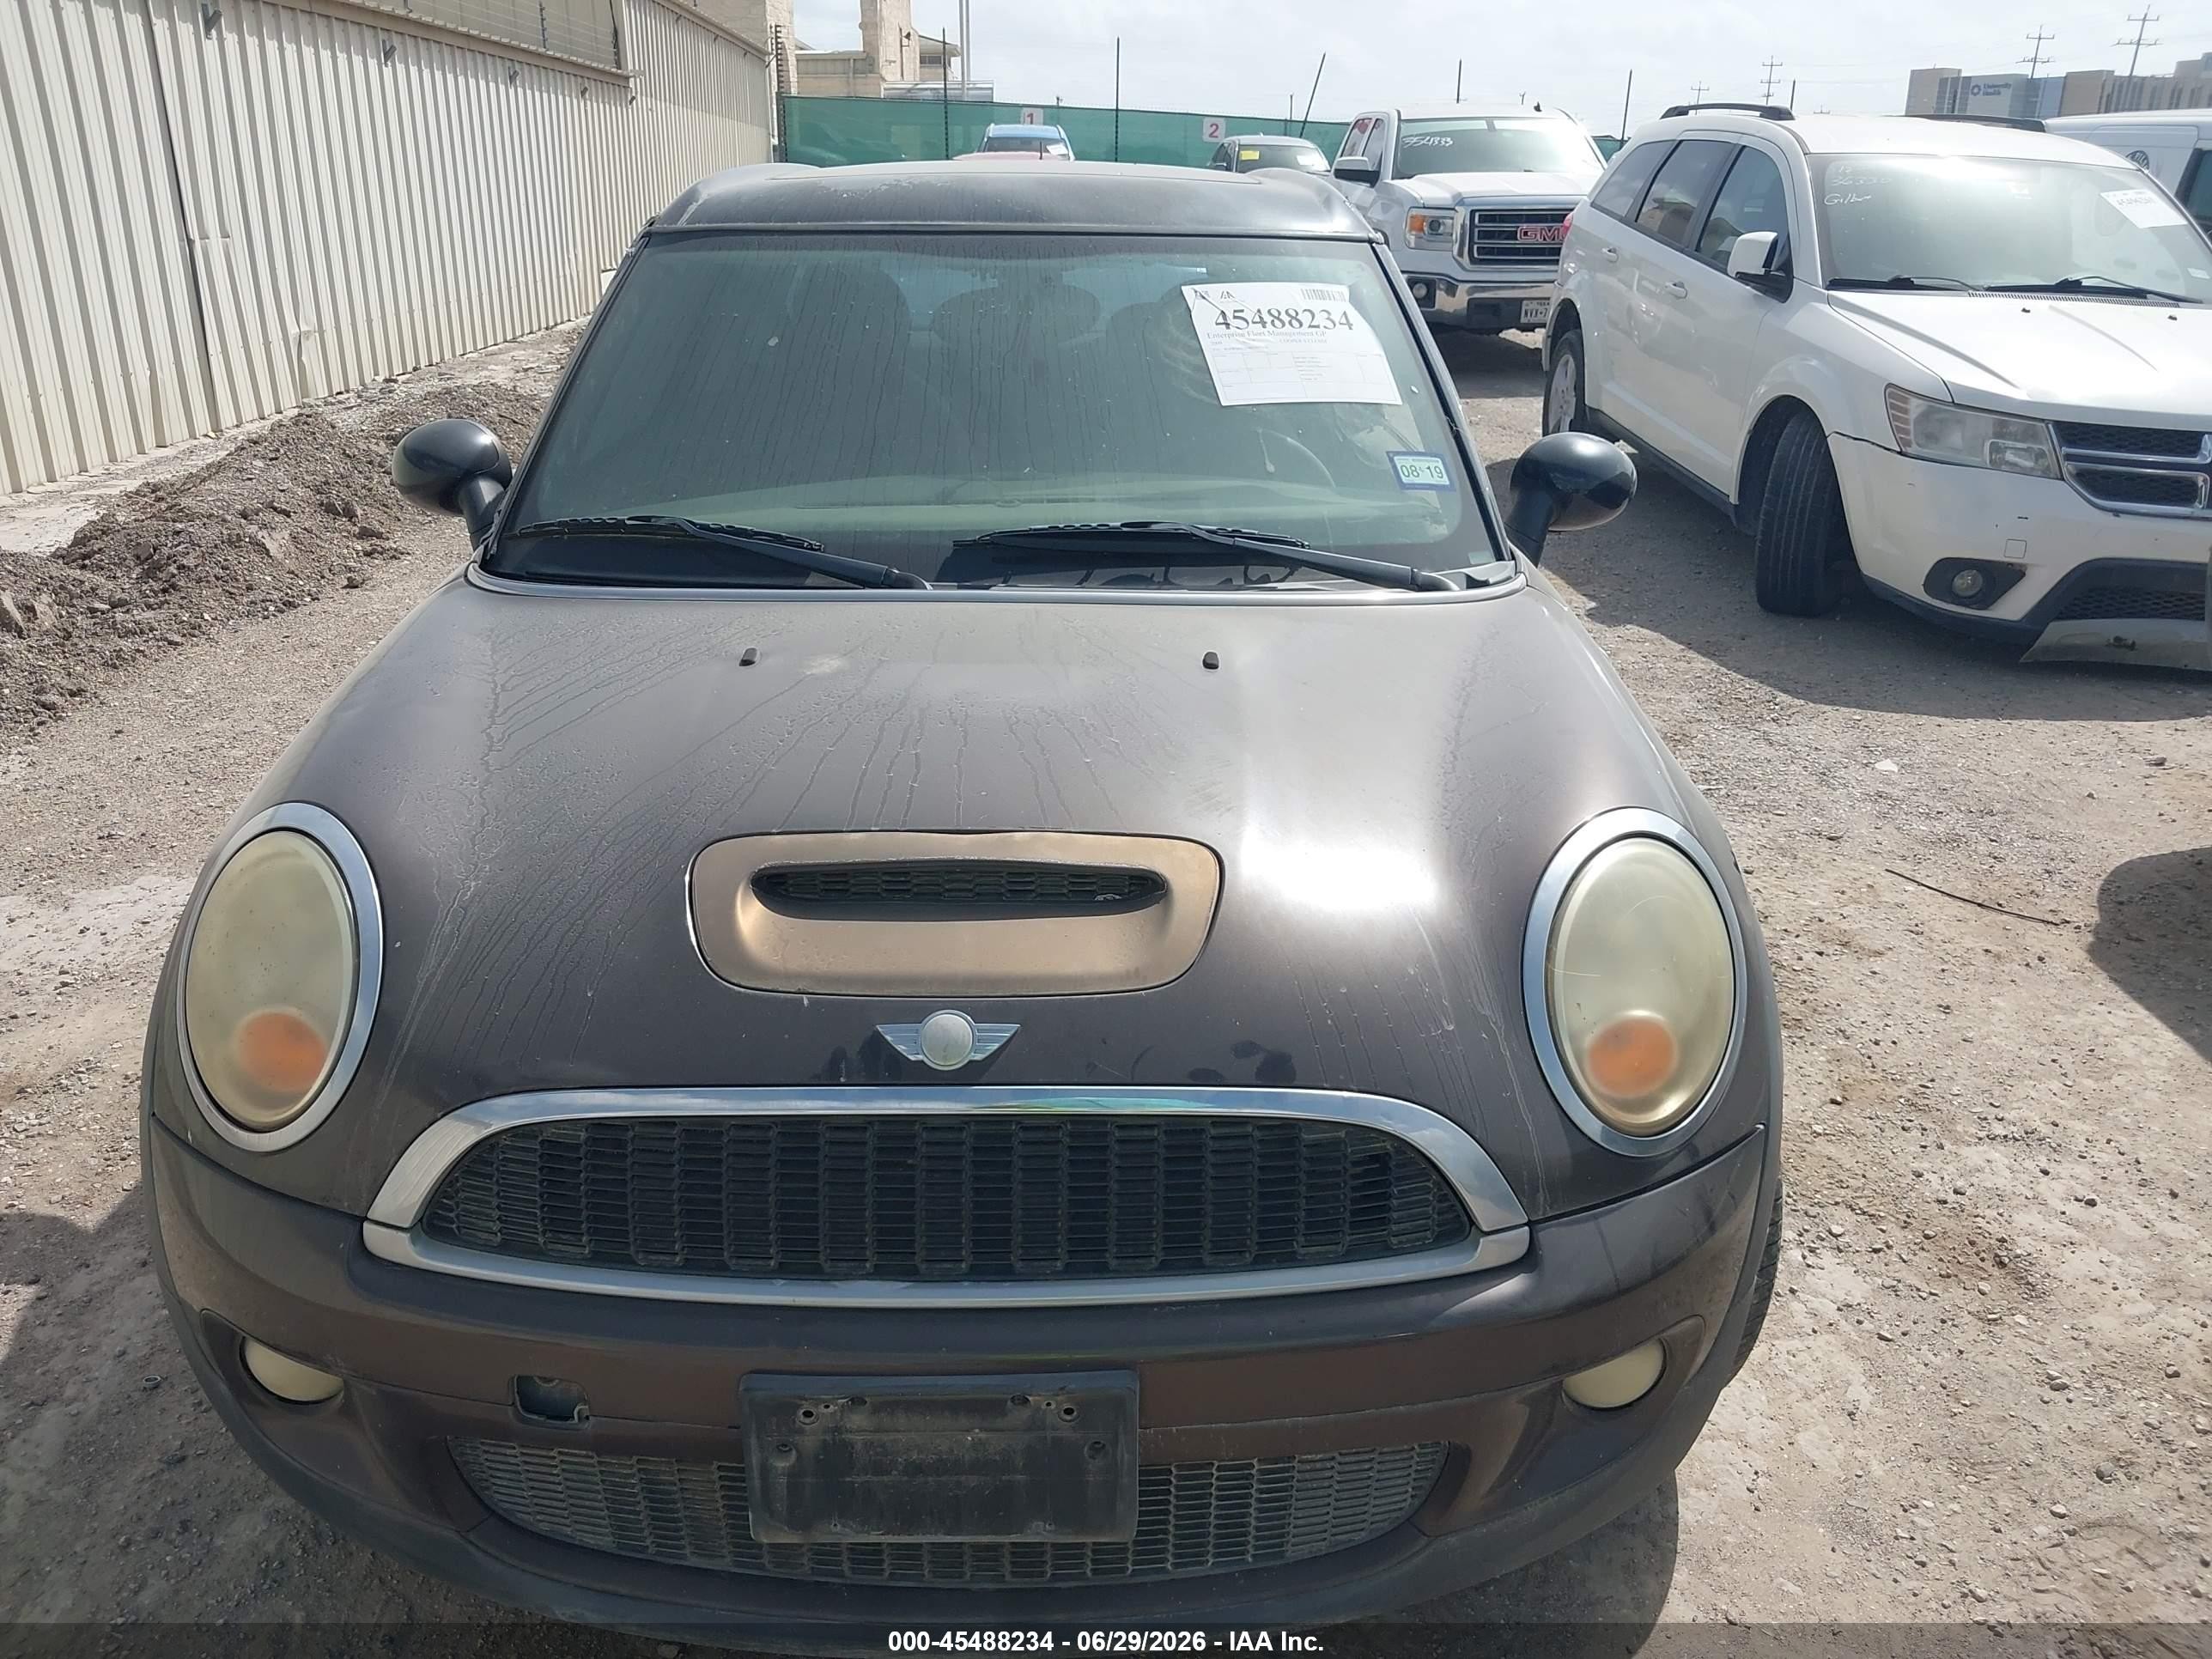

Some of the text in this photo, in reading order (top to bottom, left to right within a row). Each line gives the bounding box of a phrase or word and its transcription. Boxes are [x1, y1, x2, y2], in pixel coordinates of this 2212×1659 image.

[1026, 112, 1034, 125] 1
[1208, 123, 1219, 137] 2
[1215, 307, 1354, 331] 45488234
[1400, 465, 1444, 479] 08 19
